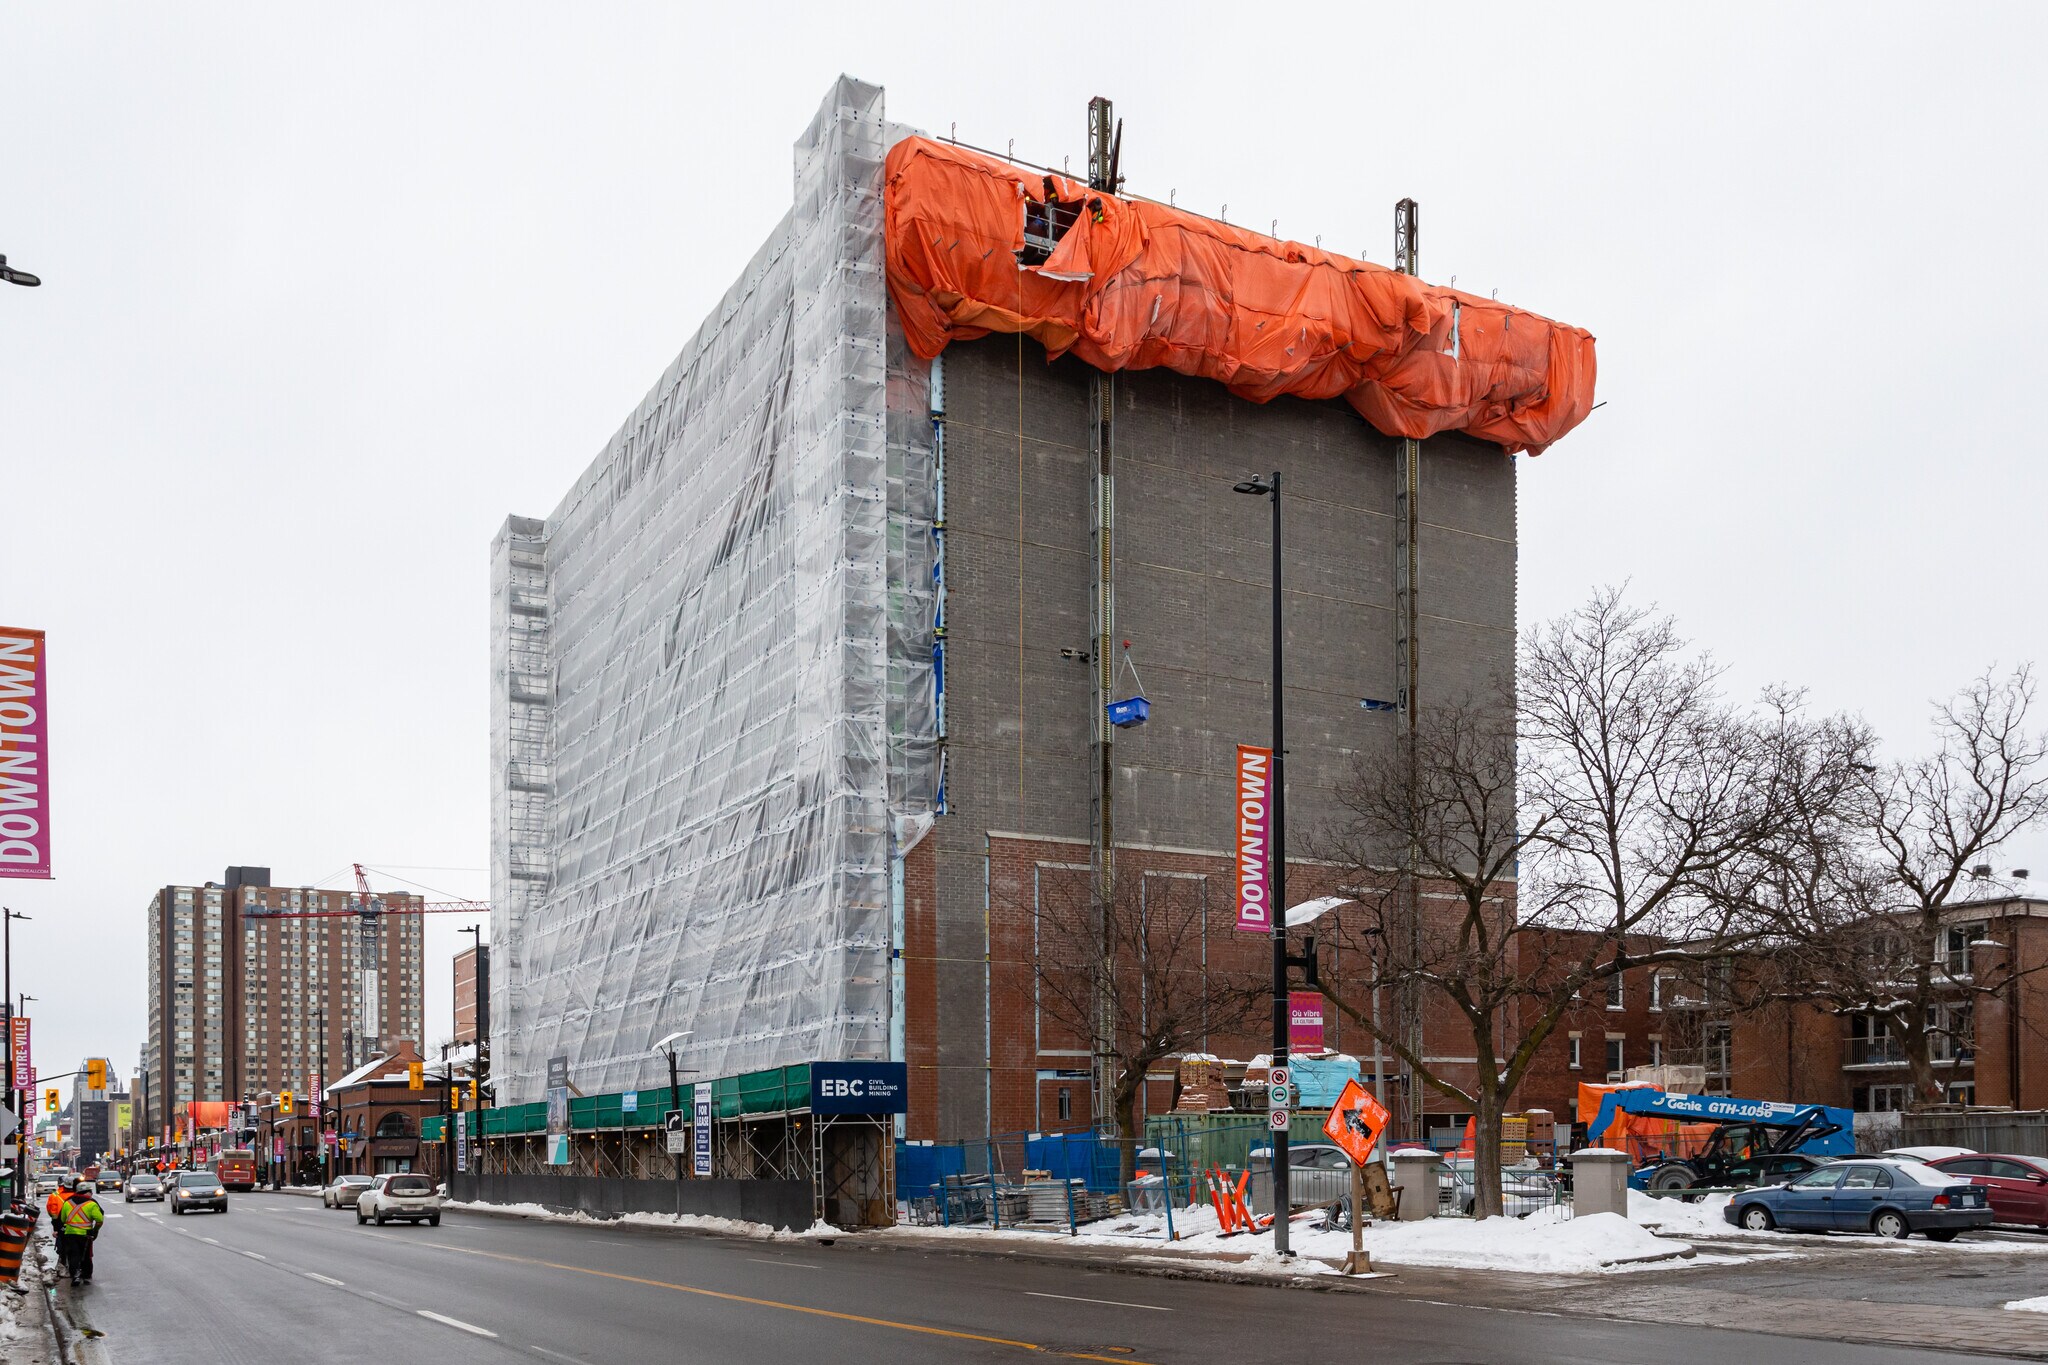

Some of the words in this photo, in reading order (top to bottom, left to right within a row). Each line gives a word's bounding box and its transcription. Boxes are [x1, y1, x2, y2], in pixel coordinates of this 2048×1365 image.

[0, 637, 40, 864] DOWNTOWN
[1241, 752, 1266, 921] DOWNTOWN
[15, 1020, 28, 1086] CENTRE-VILLE
[310, 1075, 320, 1116] DOWNTOWN
[821, 1079, 863, 1097] EBC
[696, 1116, 709, 1126] LEASE
[698, 1105, 708, 1115] FOR
[1667, 1098, 1703, 1112] Genie
[1708, 1102, 1773, 1118] GTH-1056
